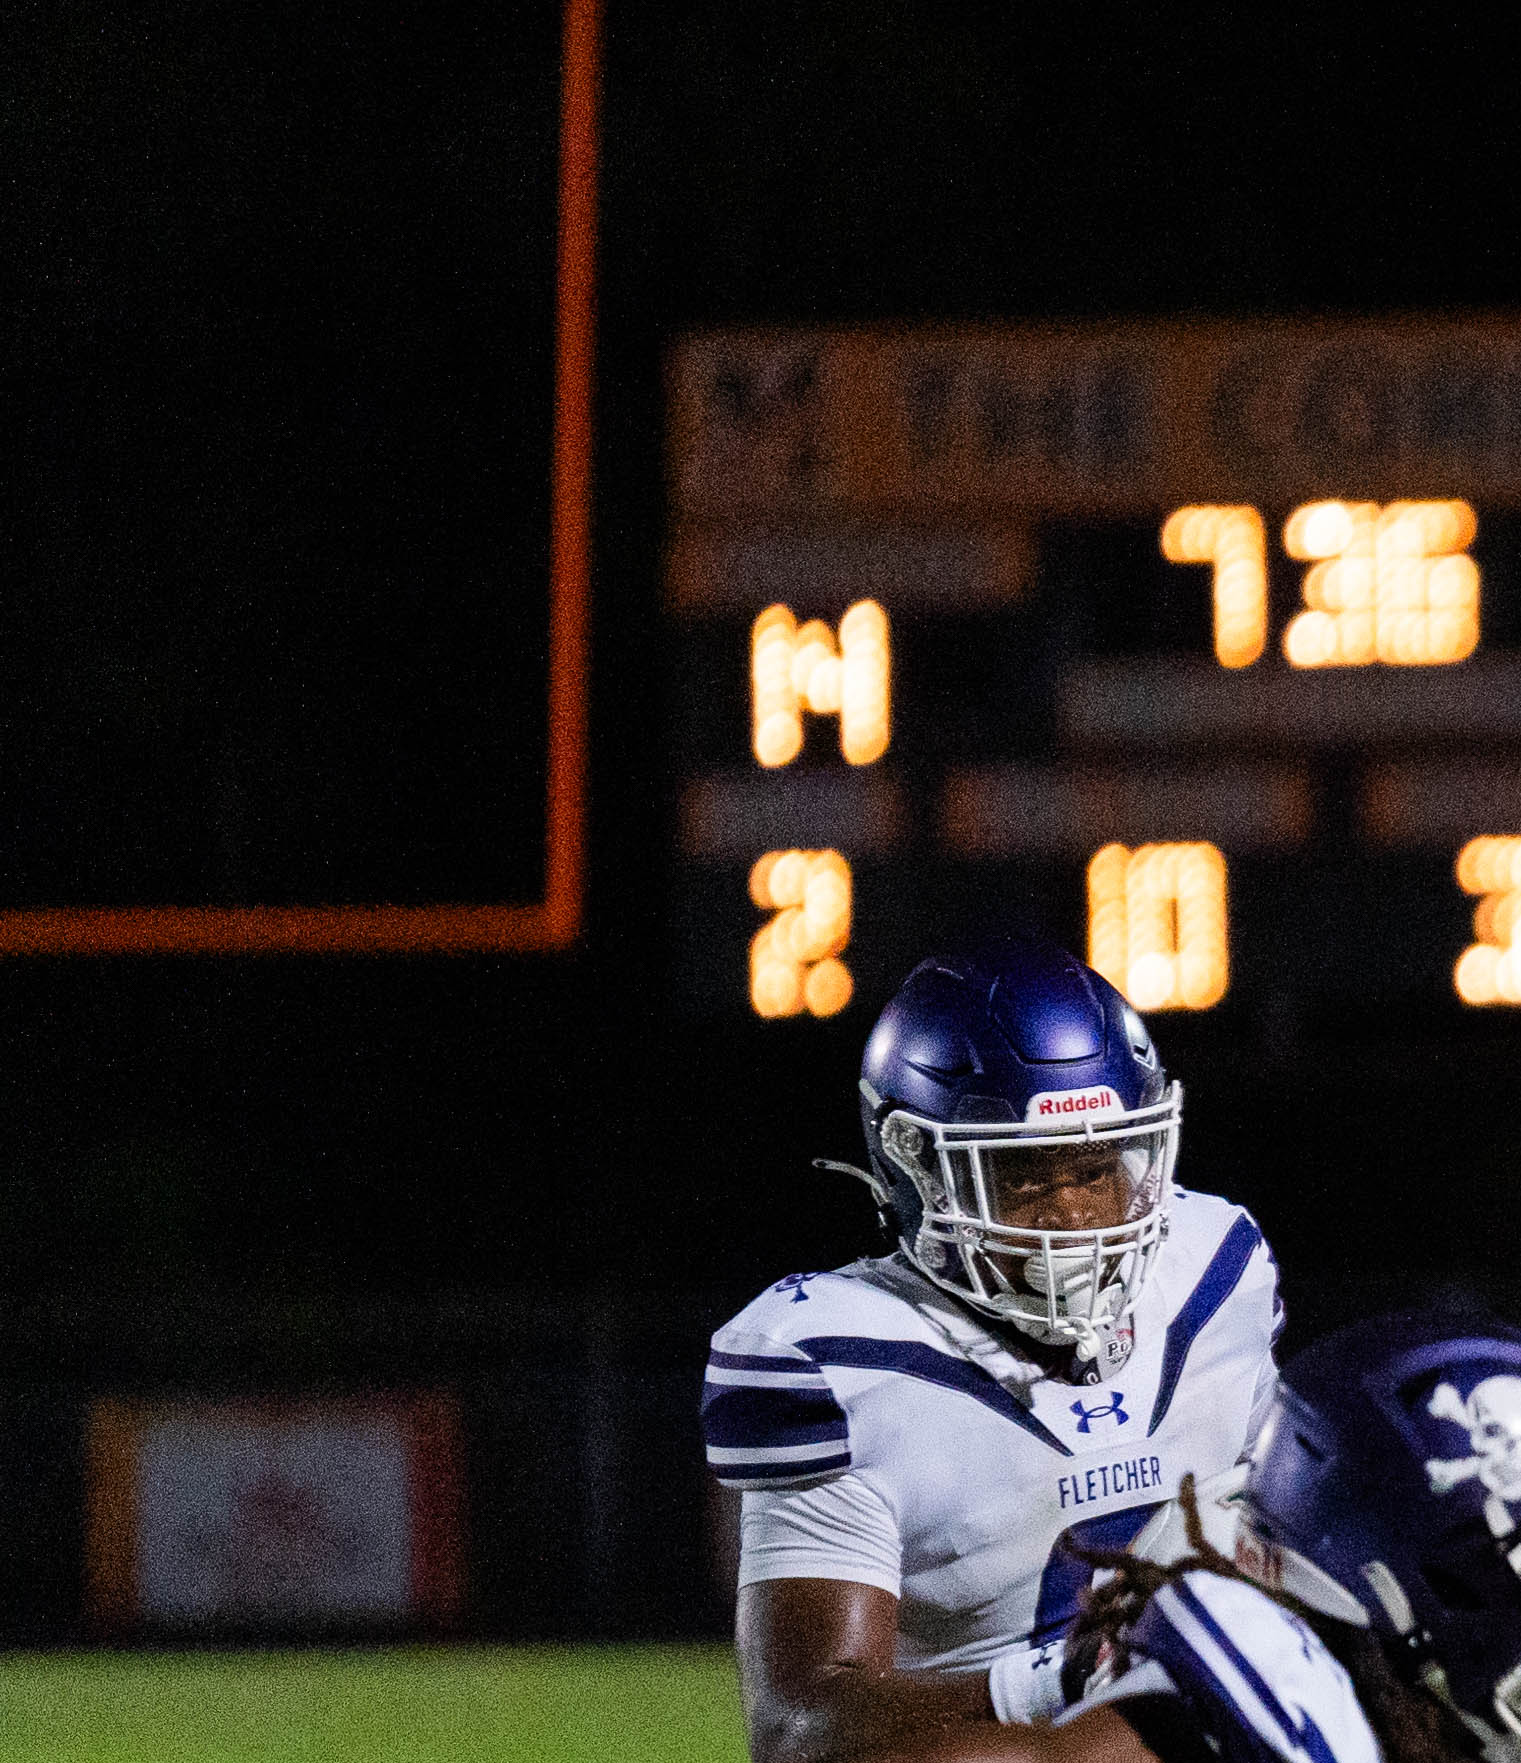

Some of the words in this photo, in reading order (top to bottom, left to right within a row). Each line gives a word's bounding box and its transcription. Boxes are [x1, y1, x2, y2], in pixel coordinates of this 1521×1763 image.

[902, 352, 1158, 472] THE
[1087, 843, 1230, 1011] 10
[1039, 1091, 1112, 1115] Riddell
[1058, 1456, 1162, 1509] FLETCHER
